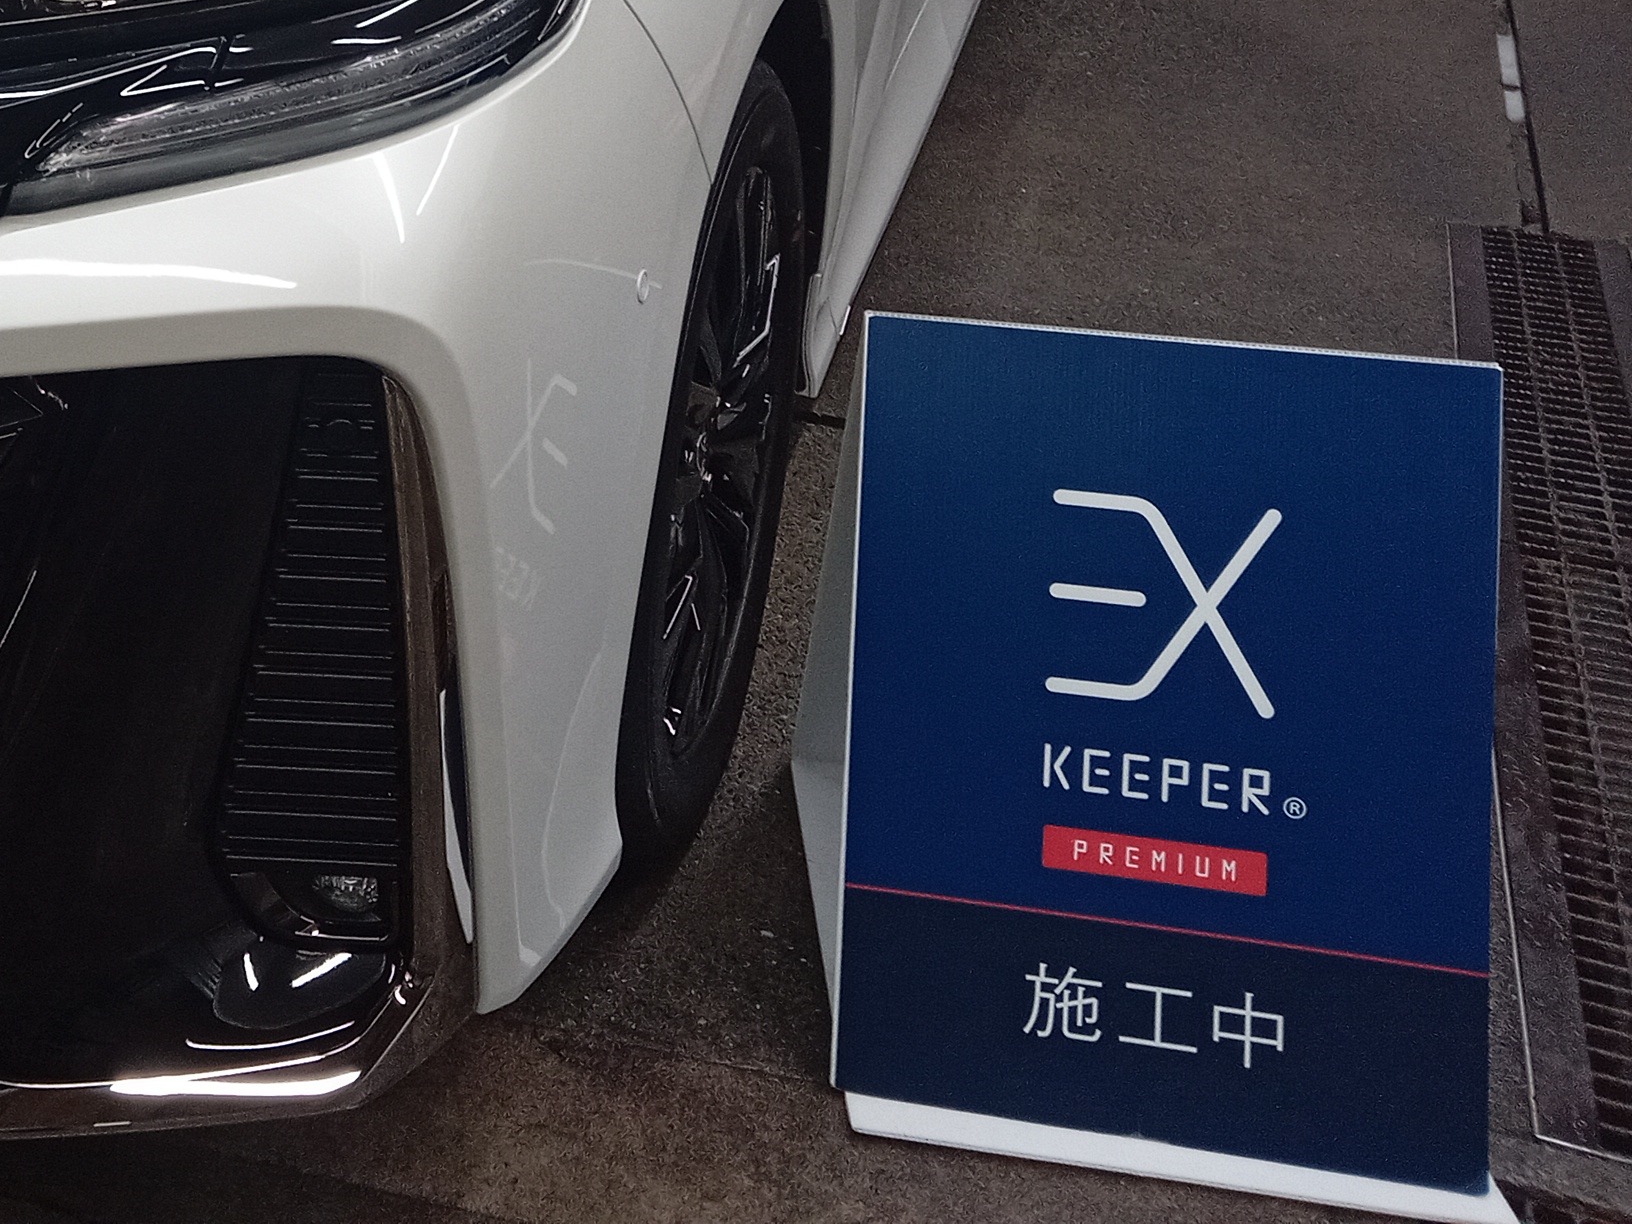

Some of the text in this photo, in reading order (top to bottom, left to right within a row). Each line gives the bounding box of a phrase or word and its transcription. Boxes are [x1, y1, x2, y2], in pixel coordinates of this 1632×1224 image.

[1045, 488, 1282, 719] EX
[1043, 742, 1271, 816] KEEPER
[1073, 838, 1237, 882] PREMIUM
[1022, 961, 1285, 1069] 施工中
